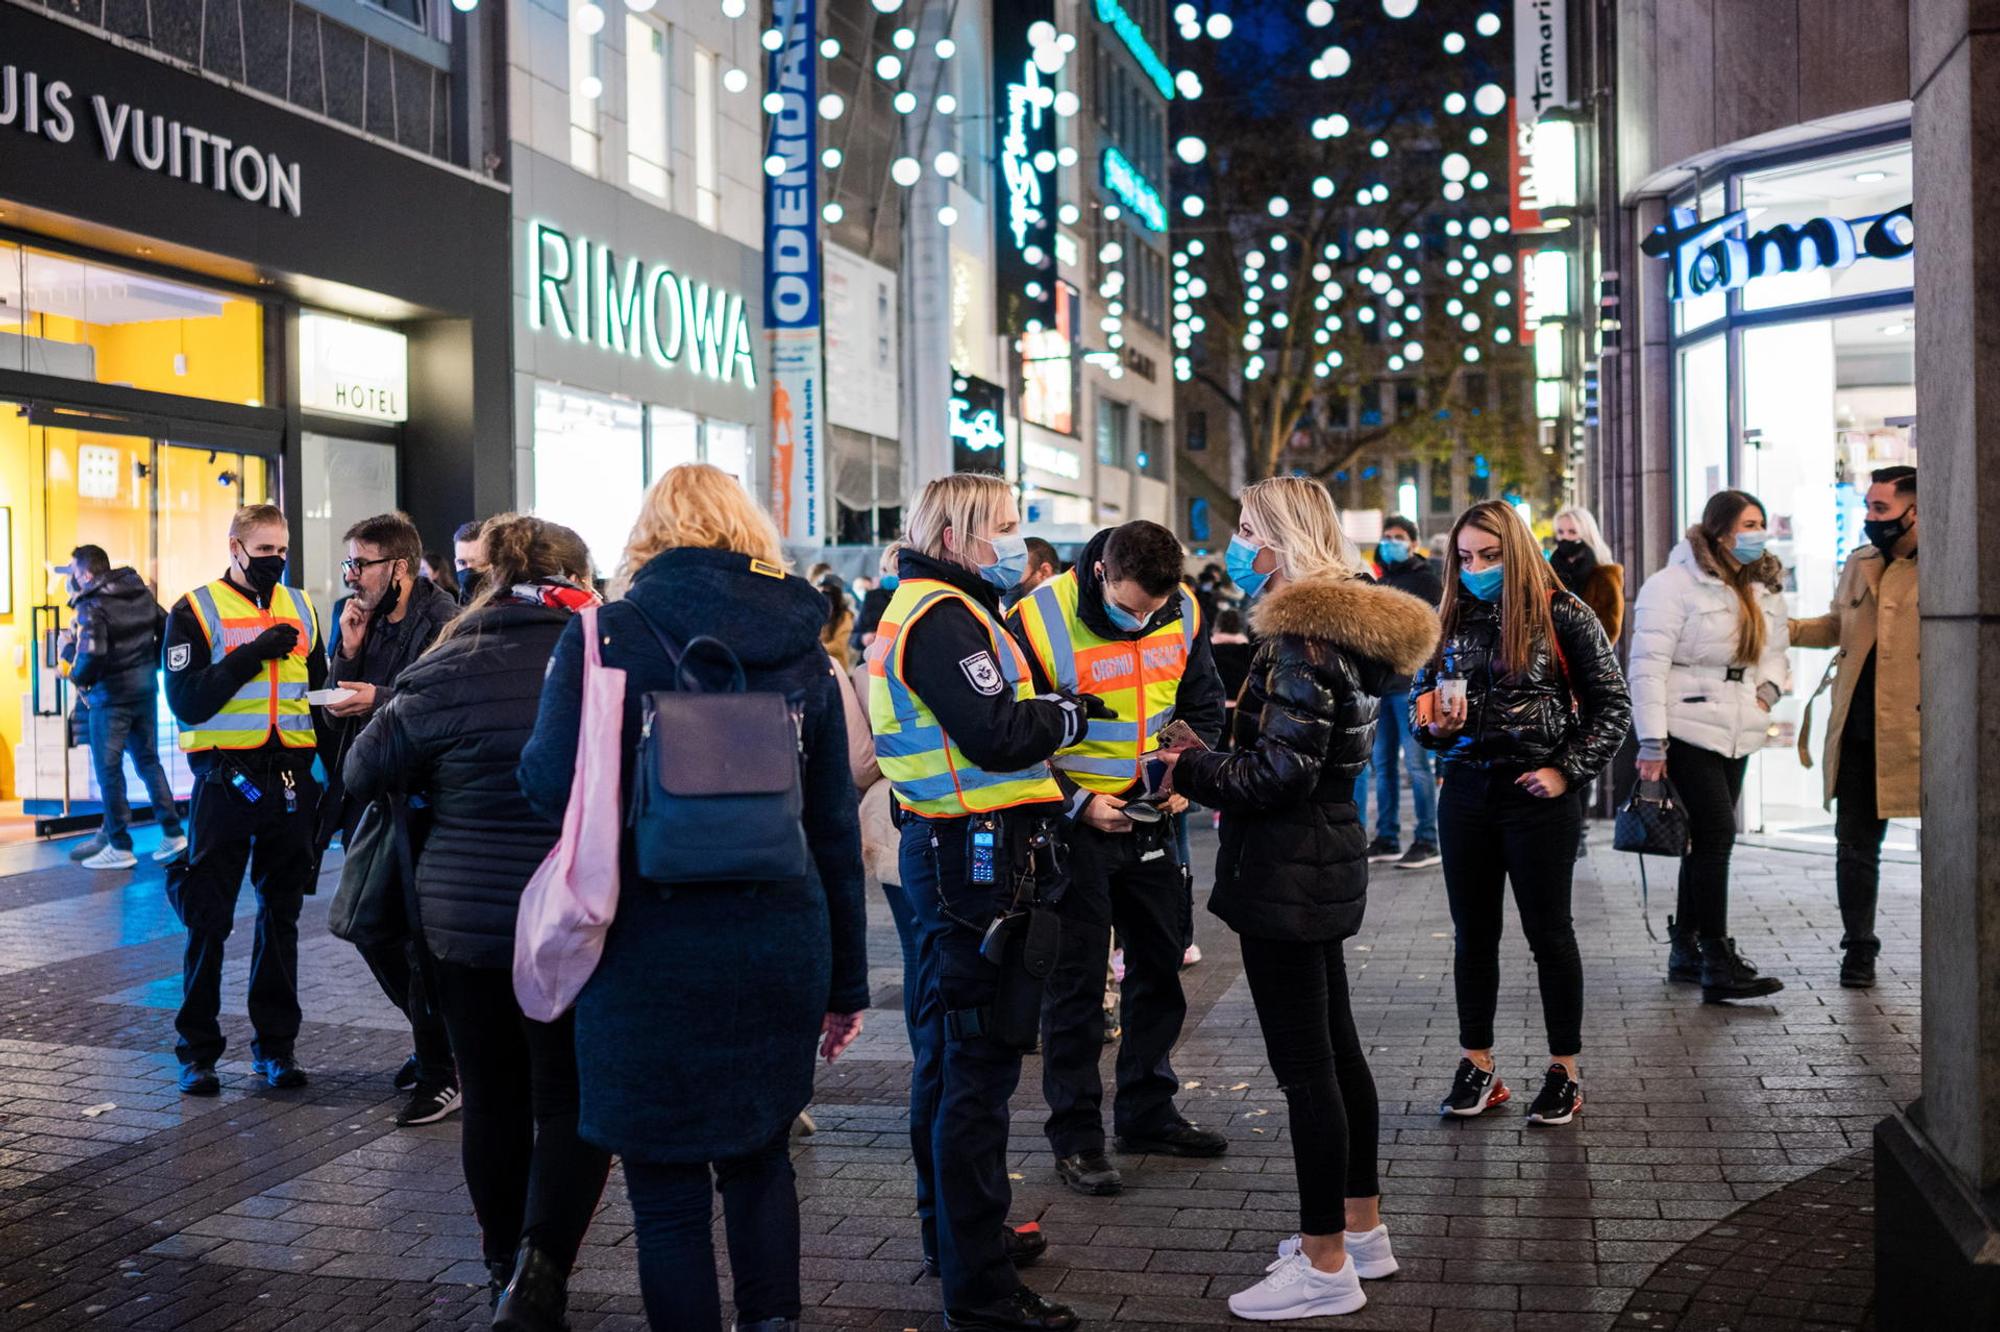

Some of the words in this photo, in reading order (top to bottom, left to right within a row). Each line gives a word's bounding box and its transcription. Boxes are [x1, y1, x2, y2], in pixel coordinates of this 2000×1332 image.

[92, 94, 301, 217] VUITTON
[528, 218, 757, 390] RIMOWA
[335, 382, 398, 415] HOTEL
